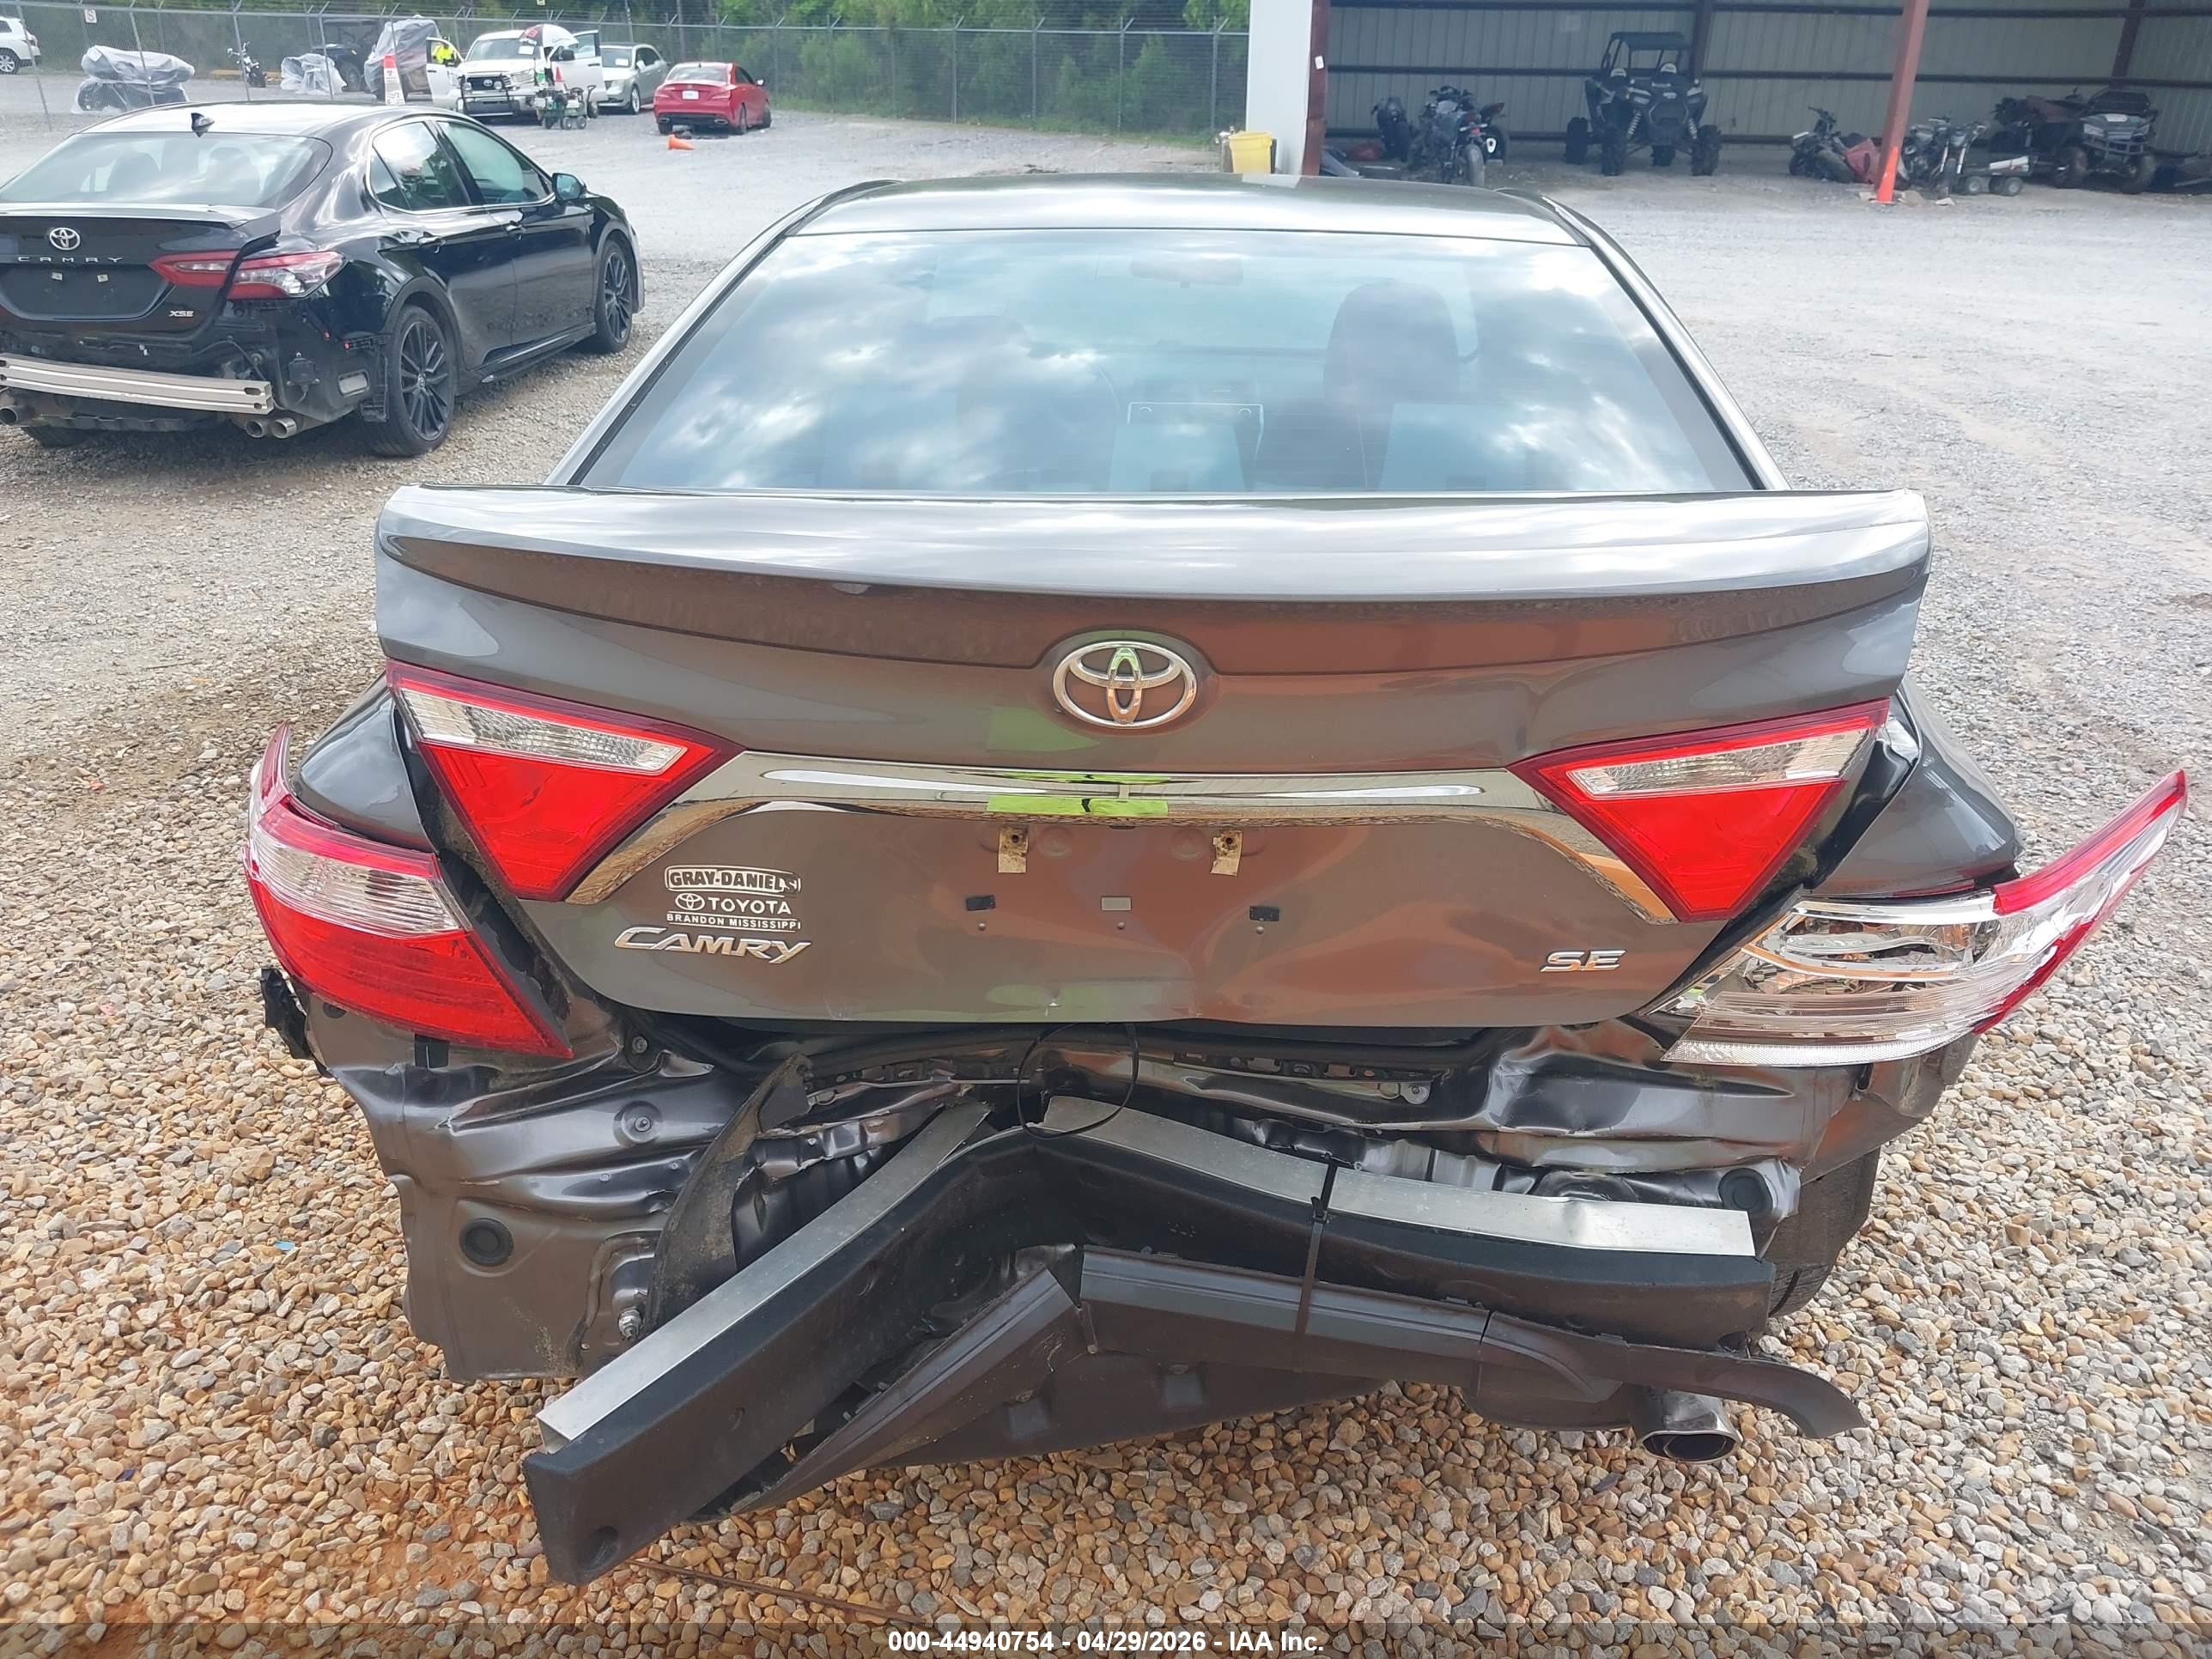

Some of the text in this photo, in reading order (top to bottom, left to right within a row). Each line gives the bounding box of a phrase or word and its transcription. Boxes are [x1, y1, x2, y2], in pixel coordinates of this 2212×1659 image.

[669, 871, 798, 894] GRAY-DANIELS
[708, 896, 792, 915] TOYOTA
[666, 913, 801, 930] BRANDON MISSISSIPPI
[614, 927, 811, 963] CAMRY
[1540, 949, 1626, 973] SE
